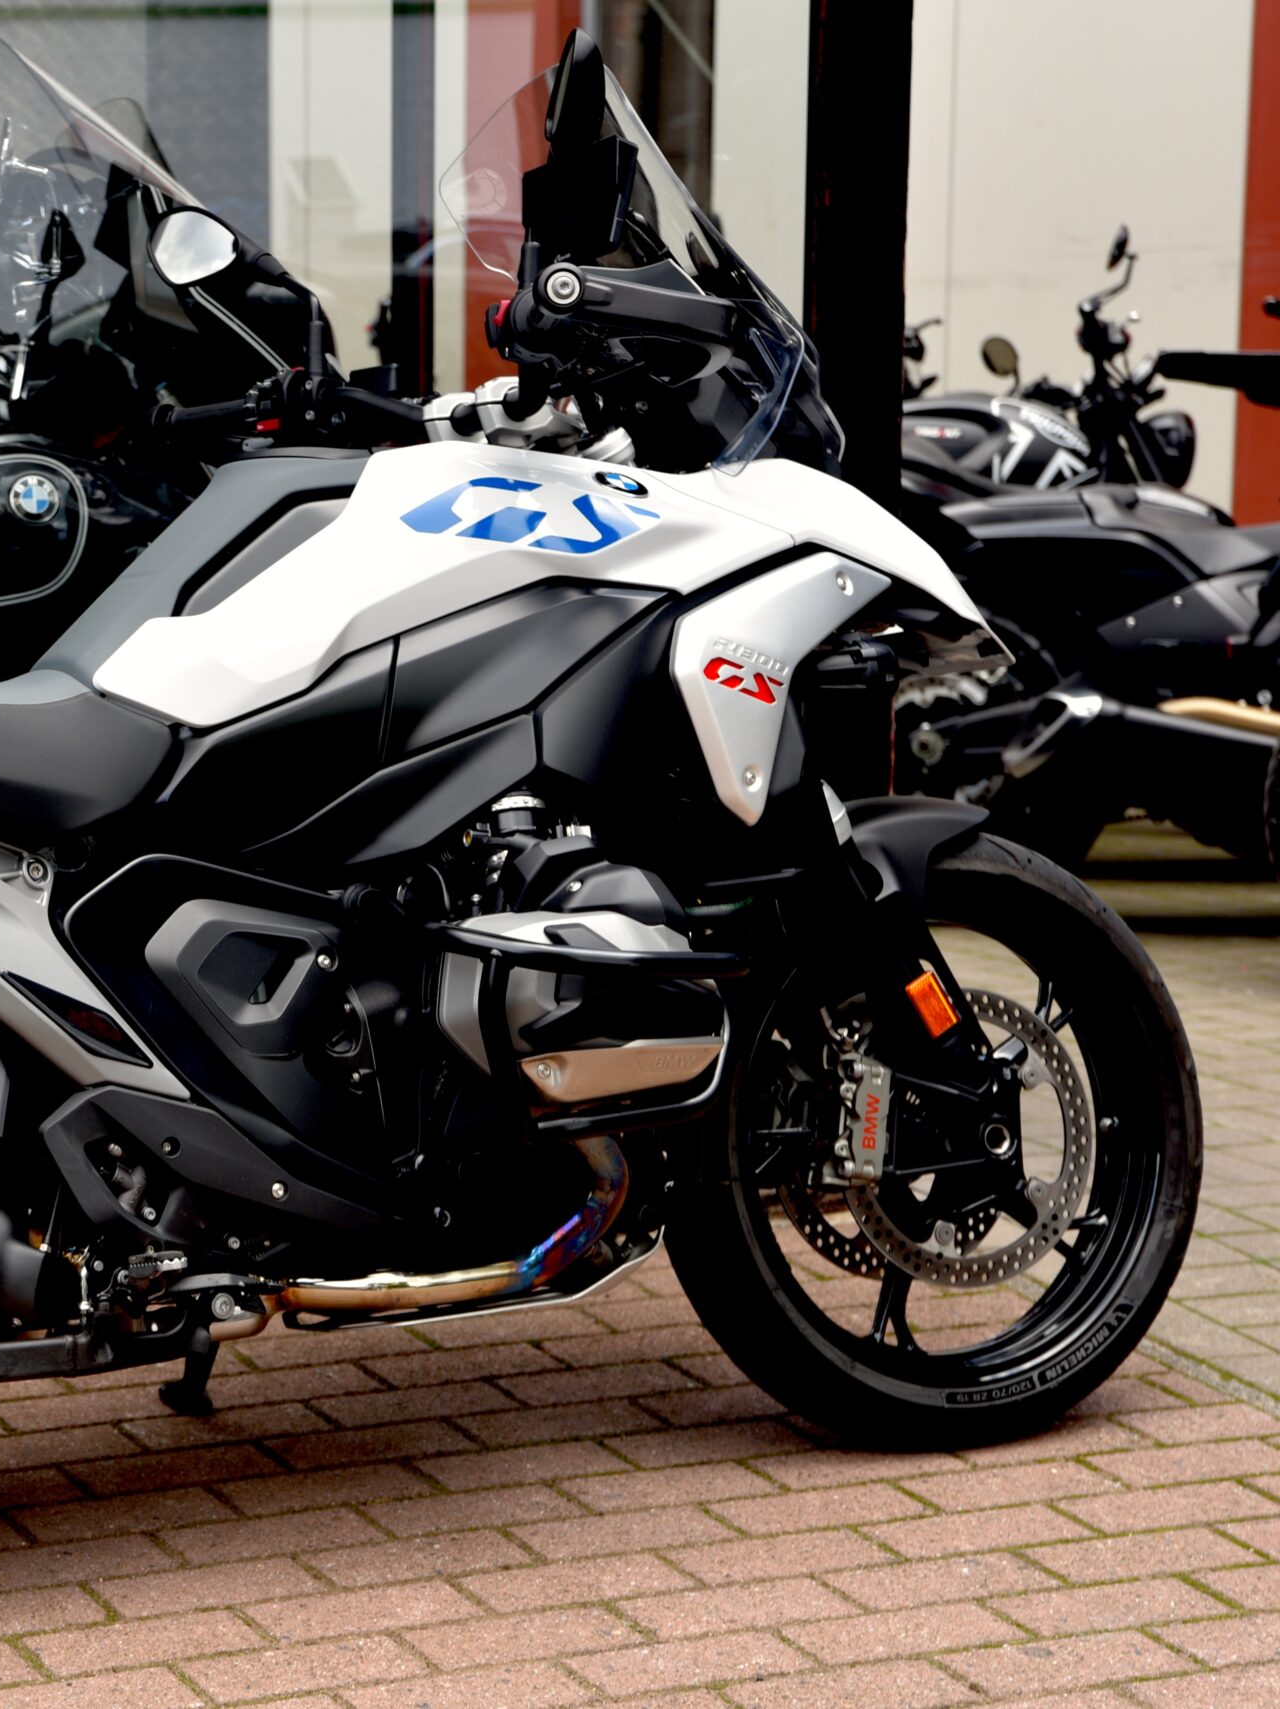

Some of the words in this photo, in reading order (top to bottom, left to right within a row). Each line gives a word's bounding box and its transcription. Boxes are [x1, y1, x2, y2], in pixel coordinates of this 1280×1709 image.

[703, 656, 784, 705] GS
[653, 1055, 697, 1069] BMW
[862, 1093, 881, 1150] BMW
[1044, 1325, 1111, 1381] MICHELIN
[992, 1379, 1033, 1399] 120/70
